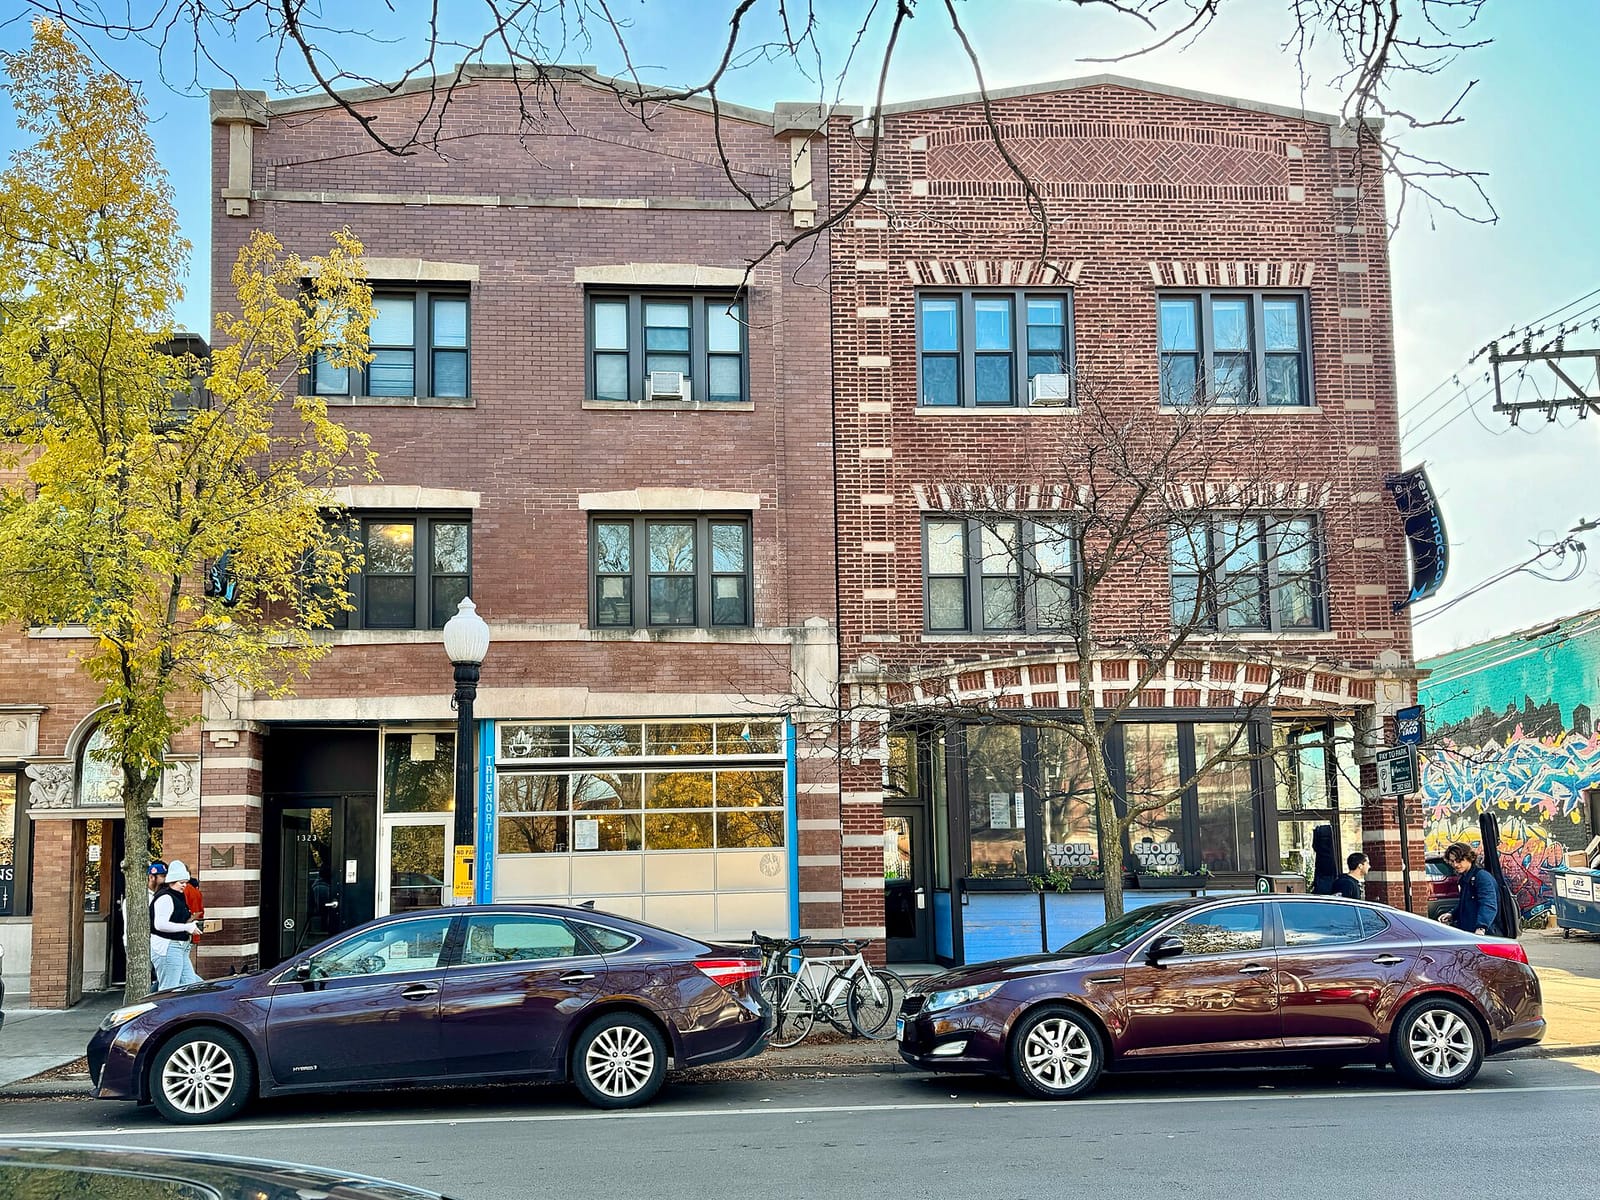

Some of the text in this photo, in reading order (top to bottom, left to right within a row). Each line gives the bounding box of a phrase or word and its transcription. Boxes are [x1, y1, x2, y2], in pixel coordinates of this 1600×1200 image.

[297, 834, 317, 842] 1323
[1047, 843, 1093, 855] SEOUL
[1134, 841, 1180, 855] SEOUL
[1051, 854, 1091, 867] TACO
[1138, 854, 1178, 866] TACO
[484, 851, 492, 890] CAFE
